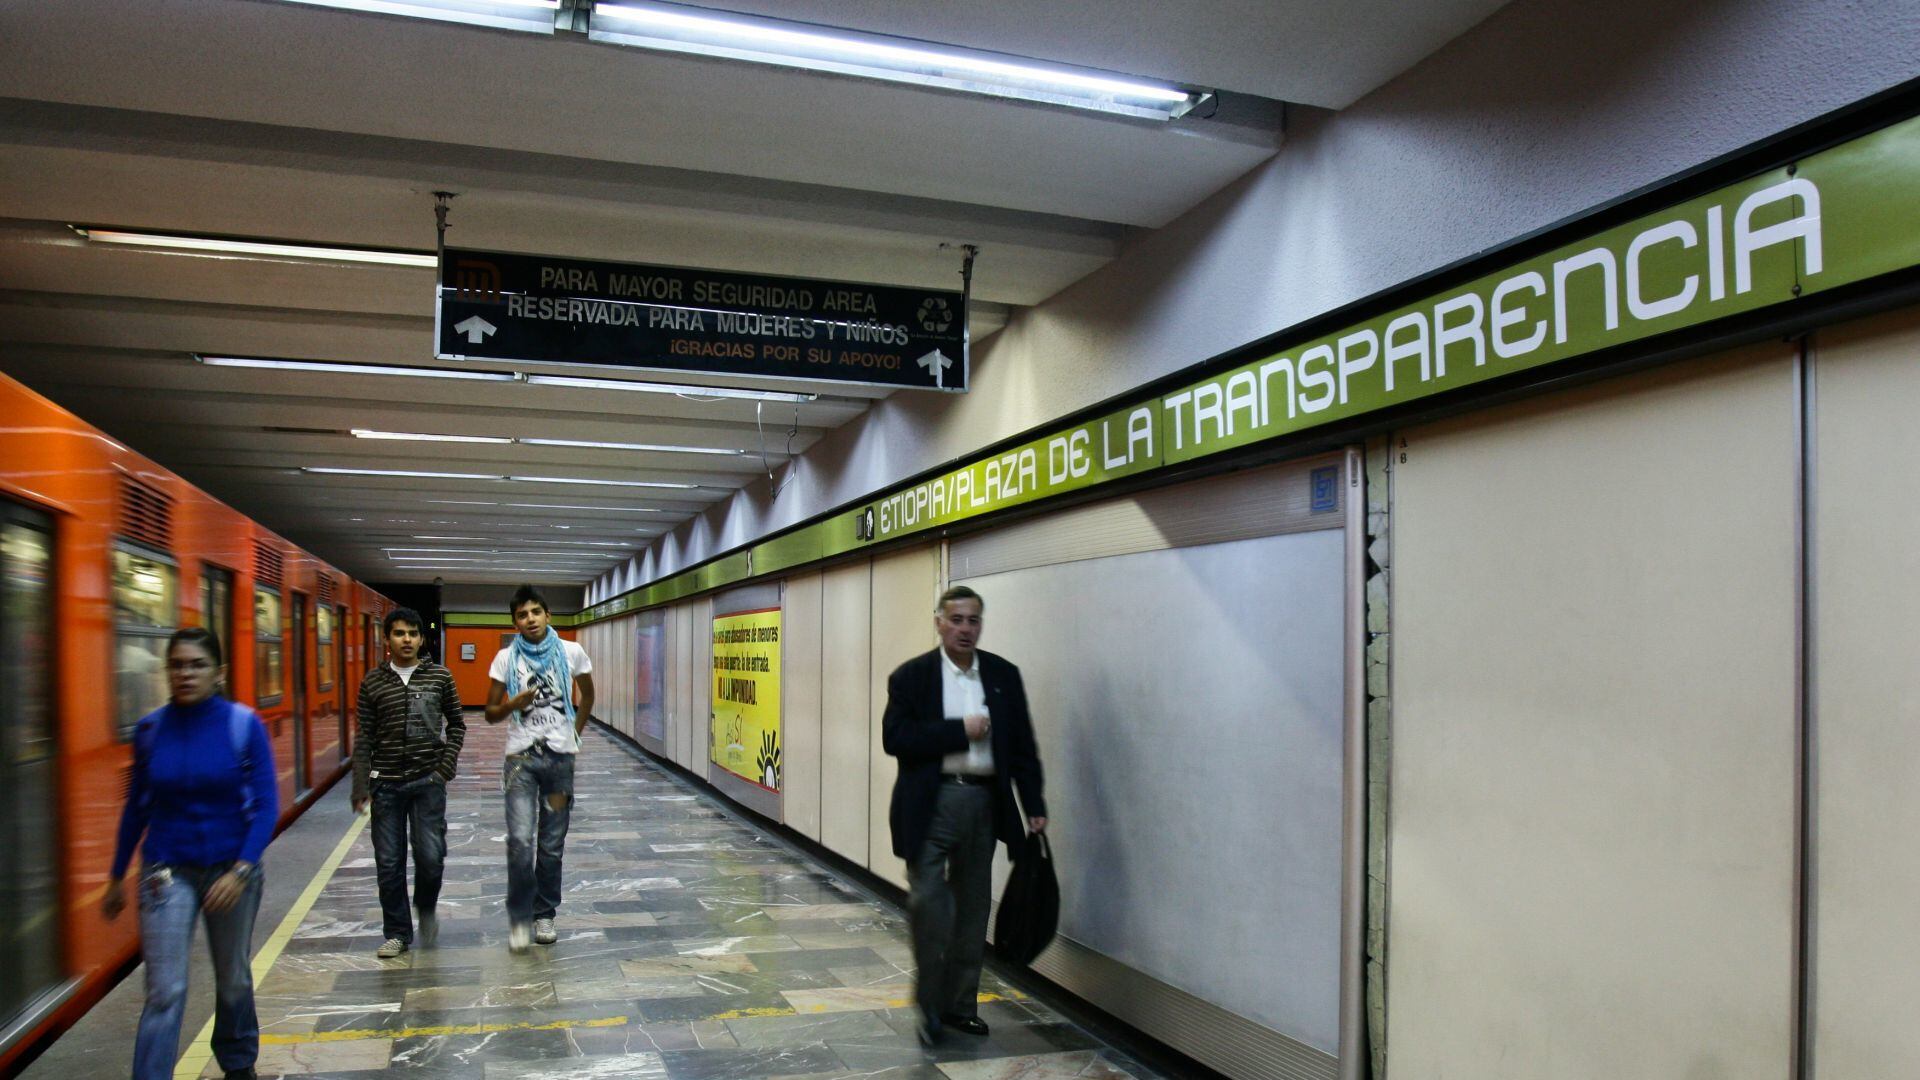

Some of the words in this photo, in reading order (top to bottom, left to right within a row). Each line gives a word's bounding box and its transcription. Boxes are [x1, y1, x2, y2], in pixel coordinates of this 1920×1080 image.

[541, 266, 599, 292] PARA
[608, 273, 683, 300] MAYOR
[693, 280, 814, 311] SEGURIDAD
[823, 289, 877, 313] AREA
[508, 295, 640, 327] RESERVADA
[649, 307, 704, 332] PARA
[717, 312, 816, 340] MUJERES
[825, 319, 837, 341] Y
[846, 317, 909, 346] NIÑOS
[671, 338, 756, 359] ¡GRACIAS
[763, 345, 800, 362] POR
[808, 349, 832, 364] SU
[839, 353, 901, 370] APOYO!
[880, 448, 1037, 534] ETIOPIA/PLAZA
[1049, 428, 1090, 486] DE
[1103, 407, 1153, 470] LA
[1165, 177, 1823, 450] TRANSPARENCIA
[757, 626, 779, 643] menores
